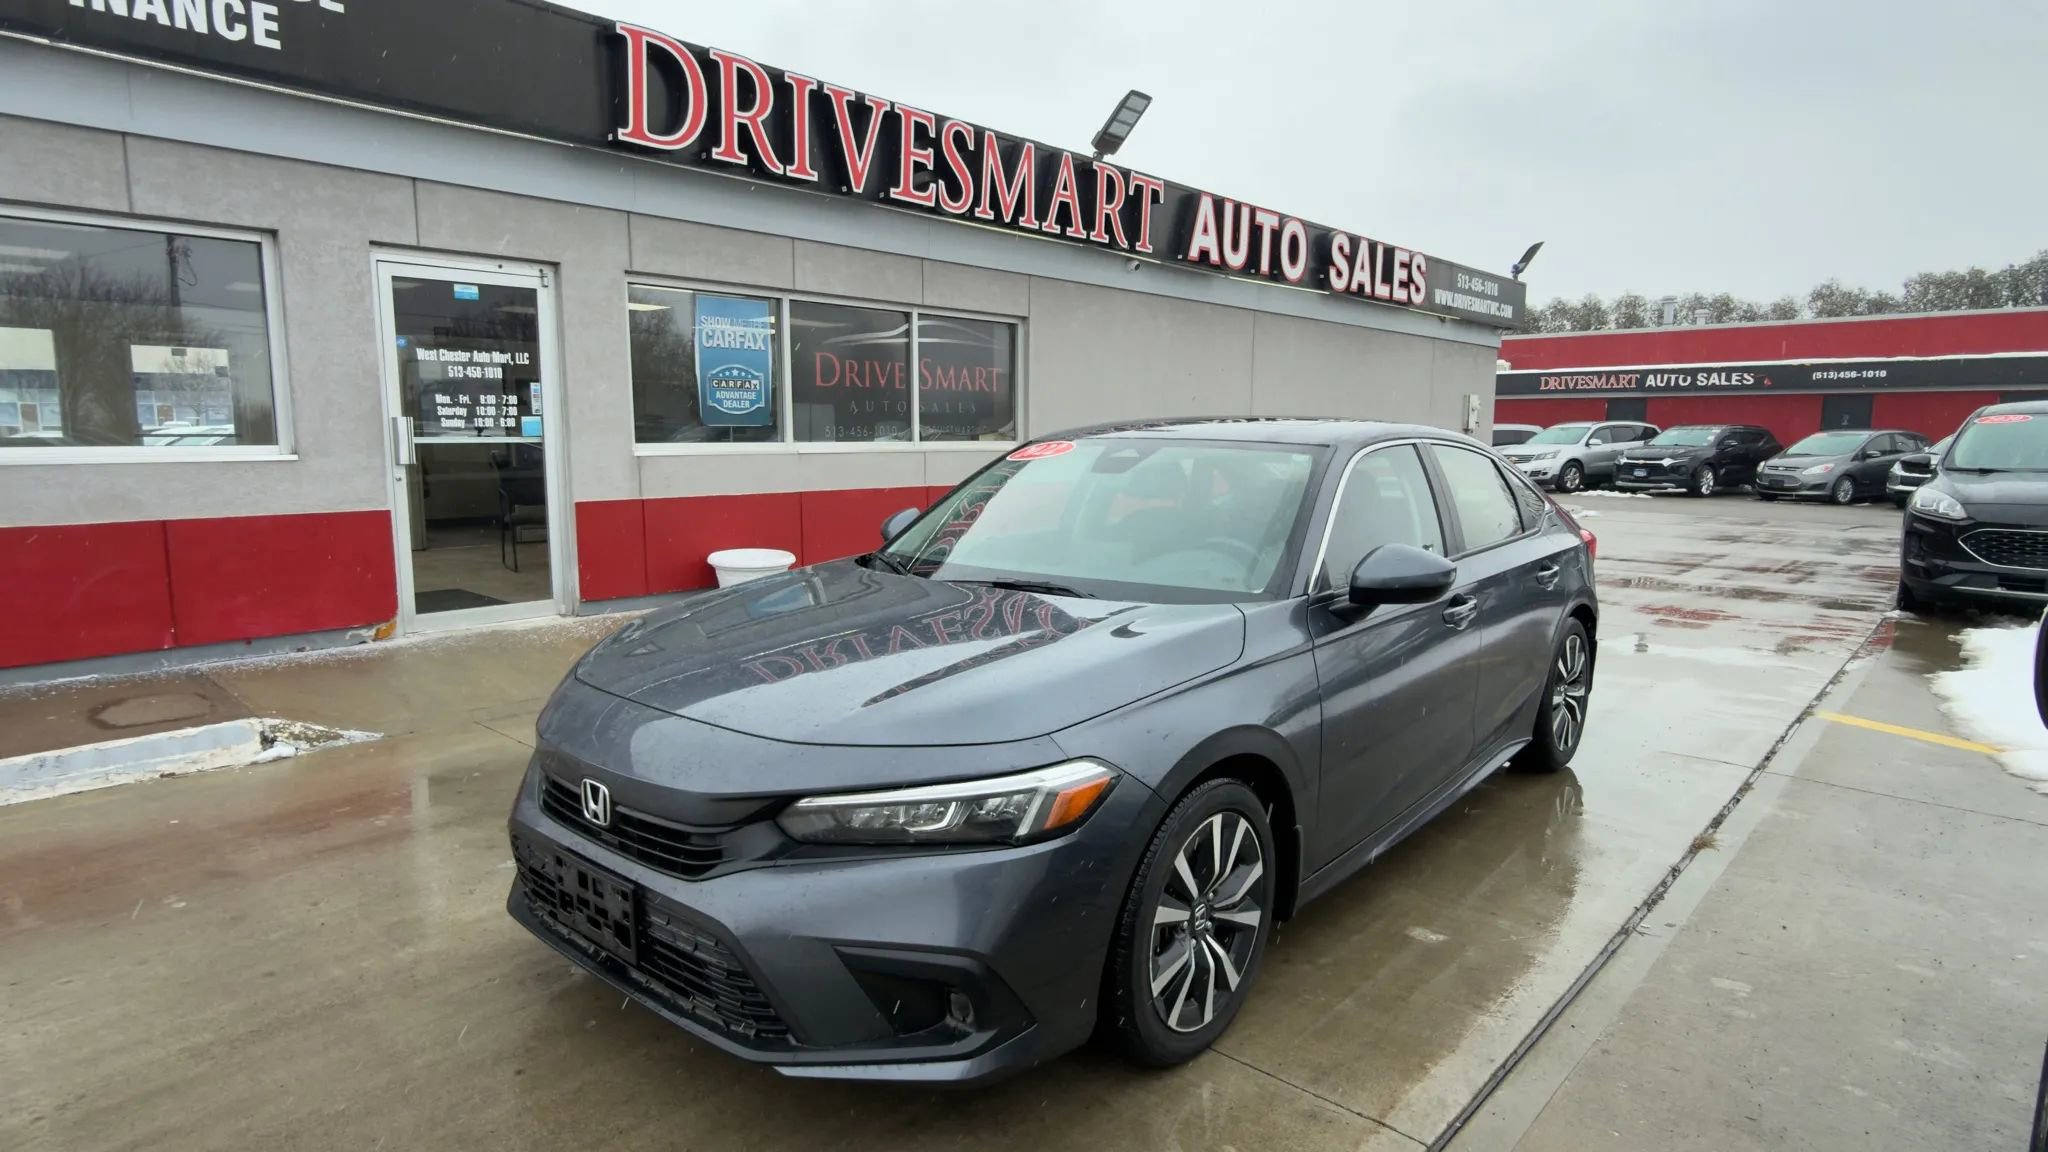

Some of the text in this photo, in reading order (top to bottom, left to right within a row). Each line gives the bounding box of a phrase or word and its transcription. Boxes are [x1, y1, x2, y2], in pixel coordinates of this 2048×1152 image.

[616, 20, 1427, 305] DRIVESMART AUTO SALES
[700, 315, 733, 328] SHOW
[702, 328, 766, 350] CARFAX
[416, 349, 438, 361] West
[439, 349, 471, 362] Chester
[473, 351, 490, 363] Auto
[516, 353, 530, 364] LLC
[1812, 370, 1887, 380] (513)456-1010
[712, 380, 759, 390] CARFAX
[1539, 372, 1755, 390] DRIVESMART AUTO SALES
[715, 391, 757, 400] ADVANTAGE
[723, 400, 750, 408] DEALER
[437, 406, 467, 417] Saturday
[441, 418, 466, 429] Sunday
